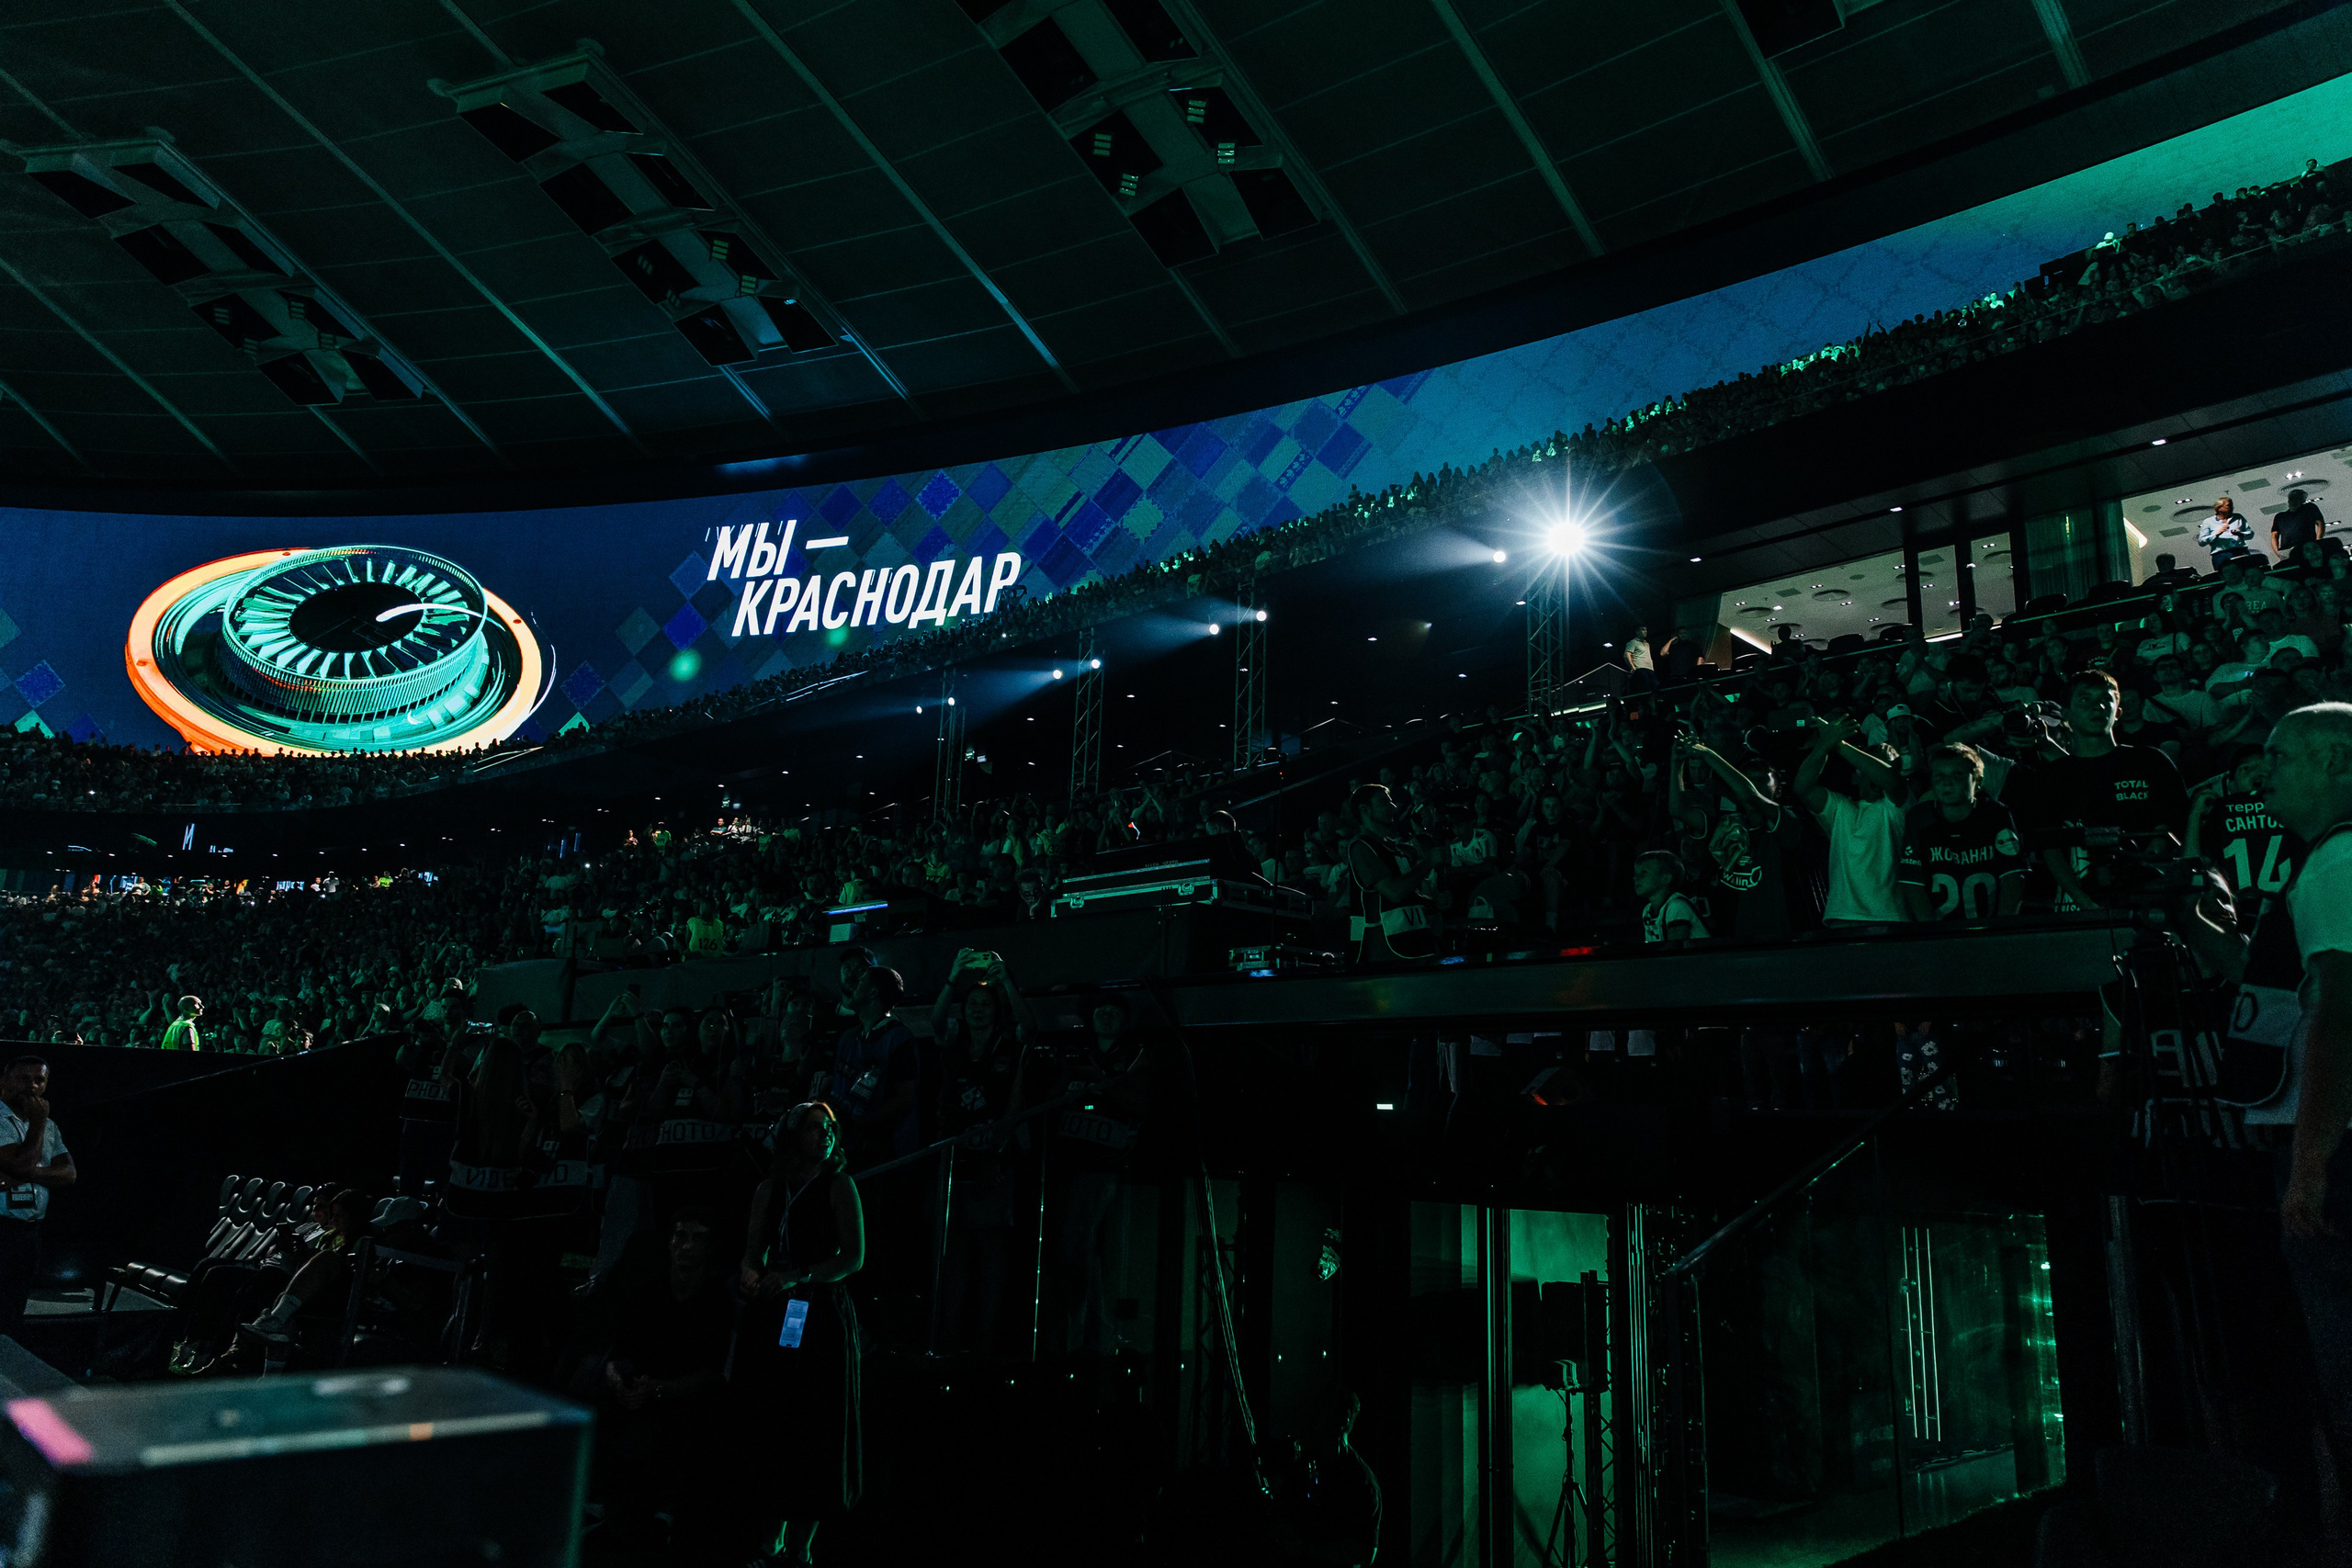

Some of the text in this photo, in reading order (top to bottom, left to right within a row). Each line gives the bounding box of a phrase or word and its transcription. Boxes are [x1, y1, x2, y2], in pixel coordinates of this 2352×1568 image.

[707, 519, 797, 581] МЫ
[731, 552, 1022, 637] КРАСНОДАР
[2113, 779, 2149, 790] TOTAL
[2115, 791, 2150, 802] BLACK
[2224, 814, 2285, 833] САНТО
[2222, 834, 2292, 893] 14
[698, 938, 718, 951] 126
[407, 1081, 447, 1099] PHO
[662, 1122, 716, 1142] HOTO
[1062, 1112, 1113, 1142] OTO
[466, 1167, 515, 1189] VIDE
